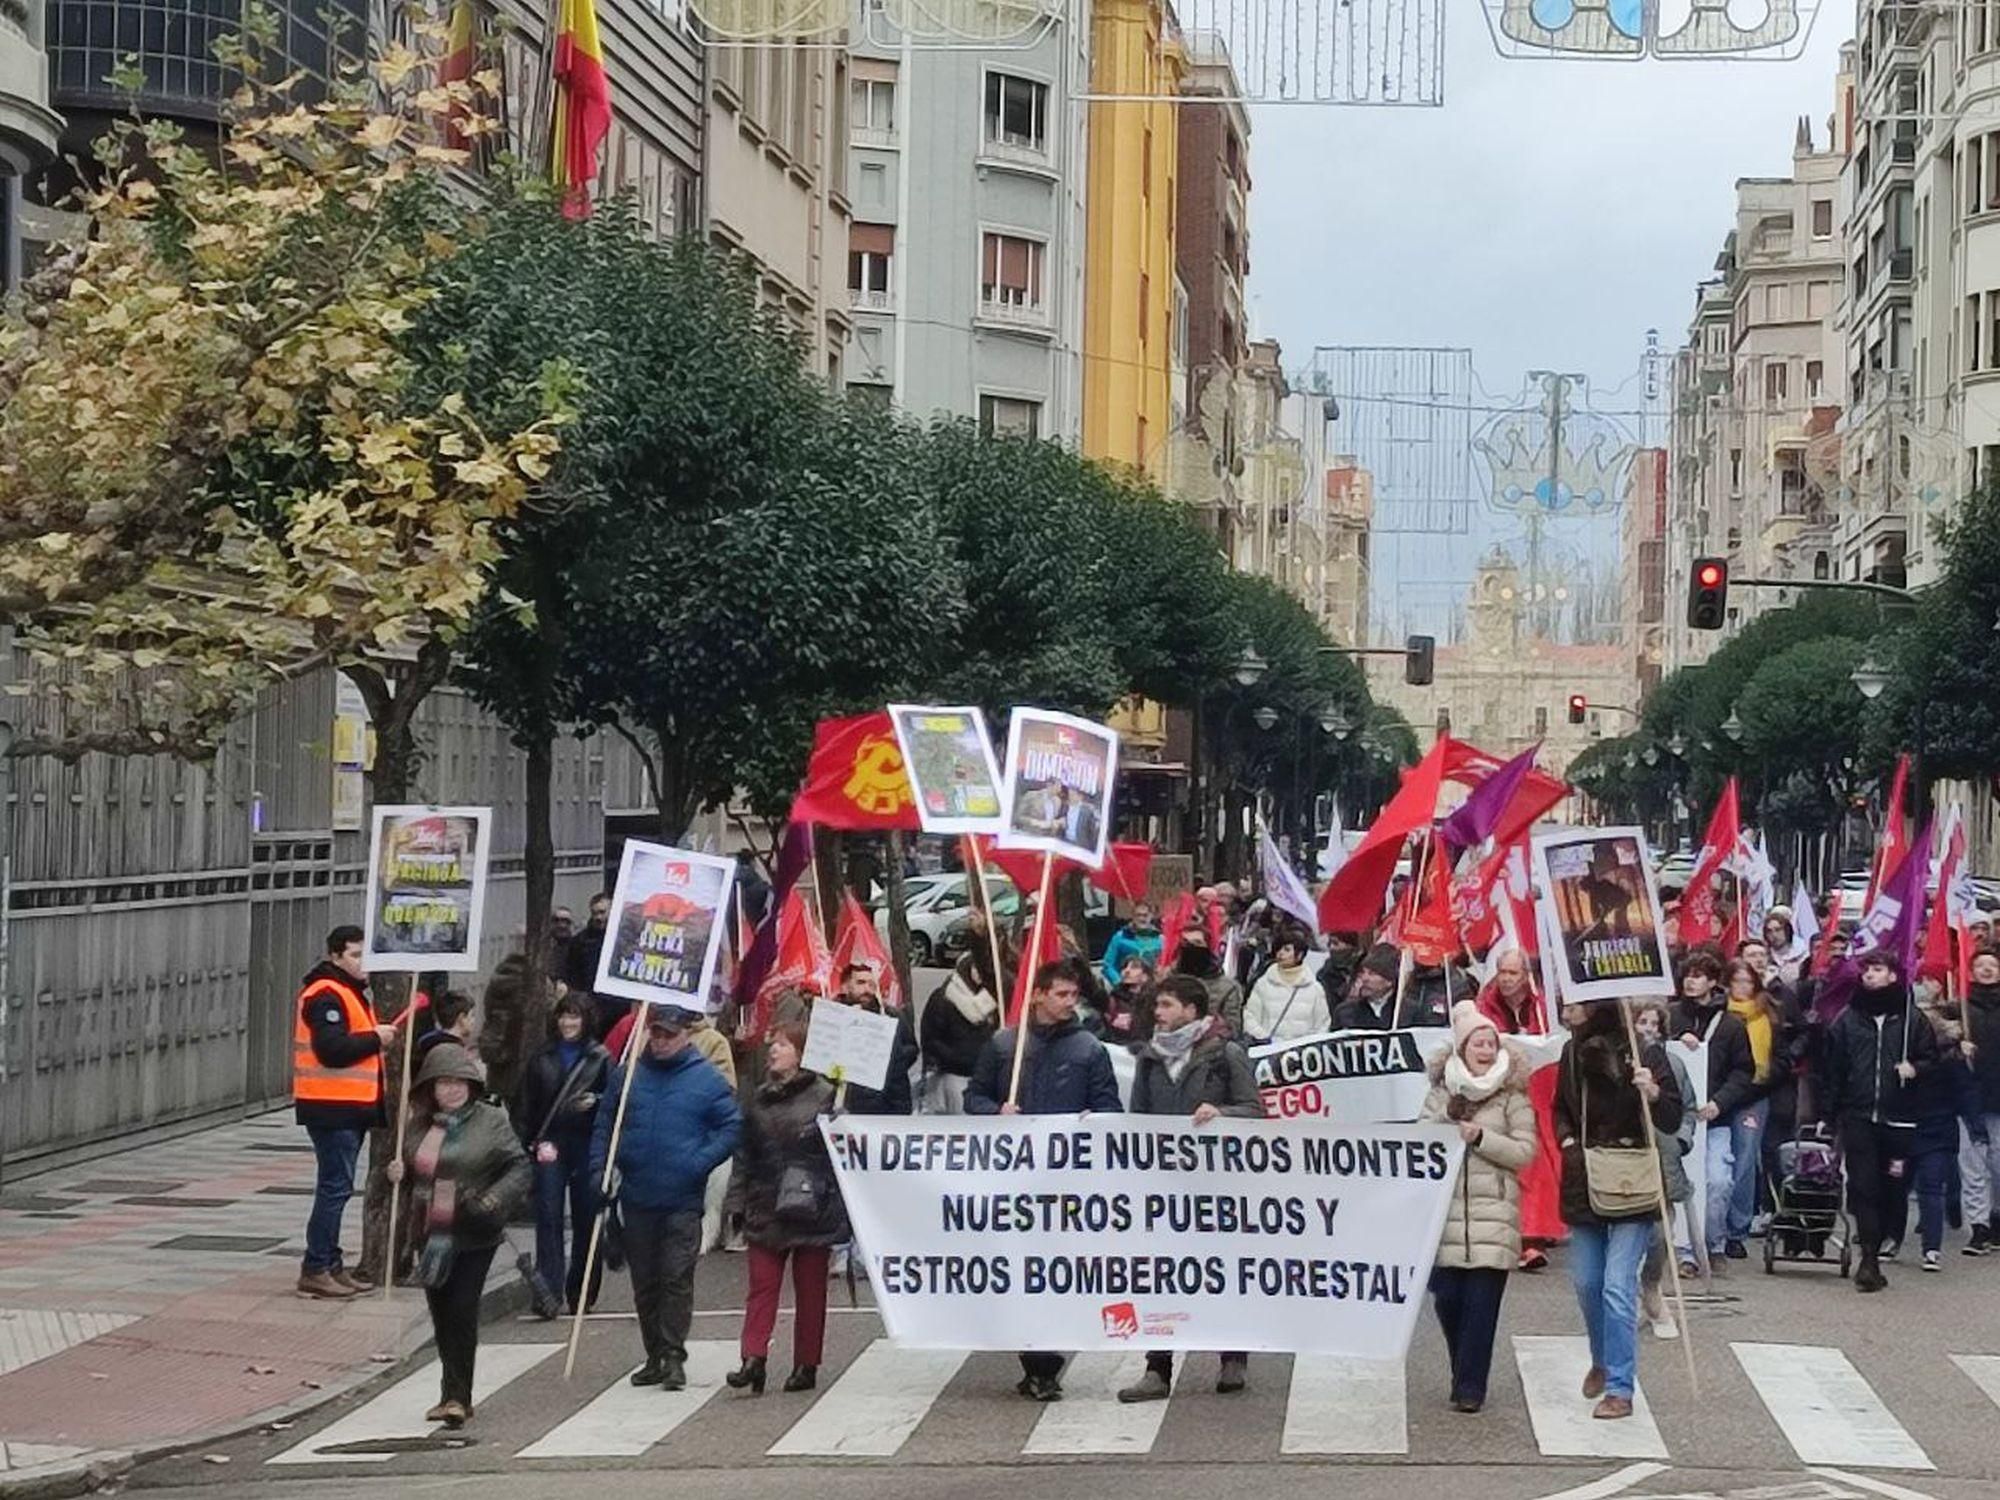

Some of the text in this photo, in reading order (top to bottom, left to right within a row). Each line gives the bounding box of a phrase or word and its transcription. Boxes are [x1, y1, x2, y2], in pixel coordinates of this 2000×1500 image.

[1647, 335, 1658, 394] HOTEL
[1280, 1036, 1409, 1083] CONTRA
[881, 1134, 1034, 1171] DEFENSA
[1047, 1132, 1092, 1171] DE
[1105, 1132, 1292, 1174] NUESTROS
[1302, 1137, 1448, 1181] MONTES
[942, 1193, 1340, 1237] NUESTROS PUEBLOS Y
[876, 1255, 1415, 1304] ESTROS BOMBEROS FORESTAL
